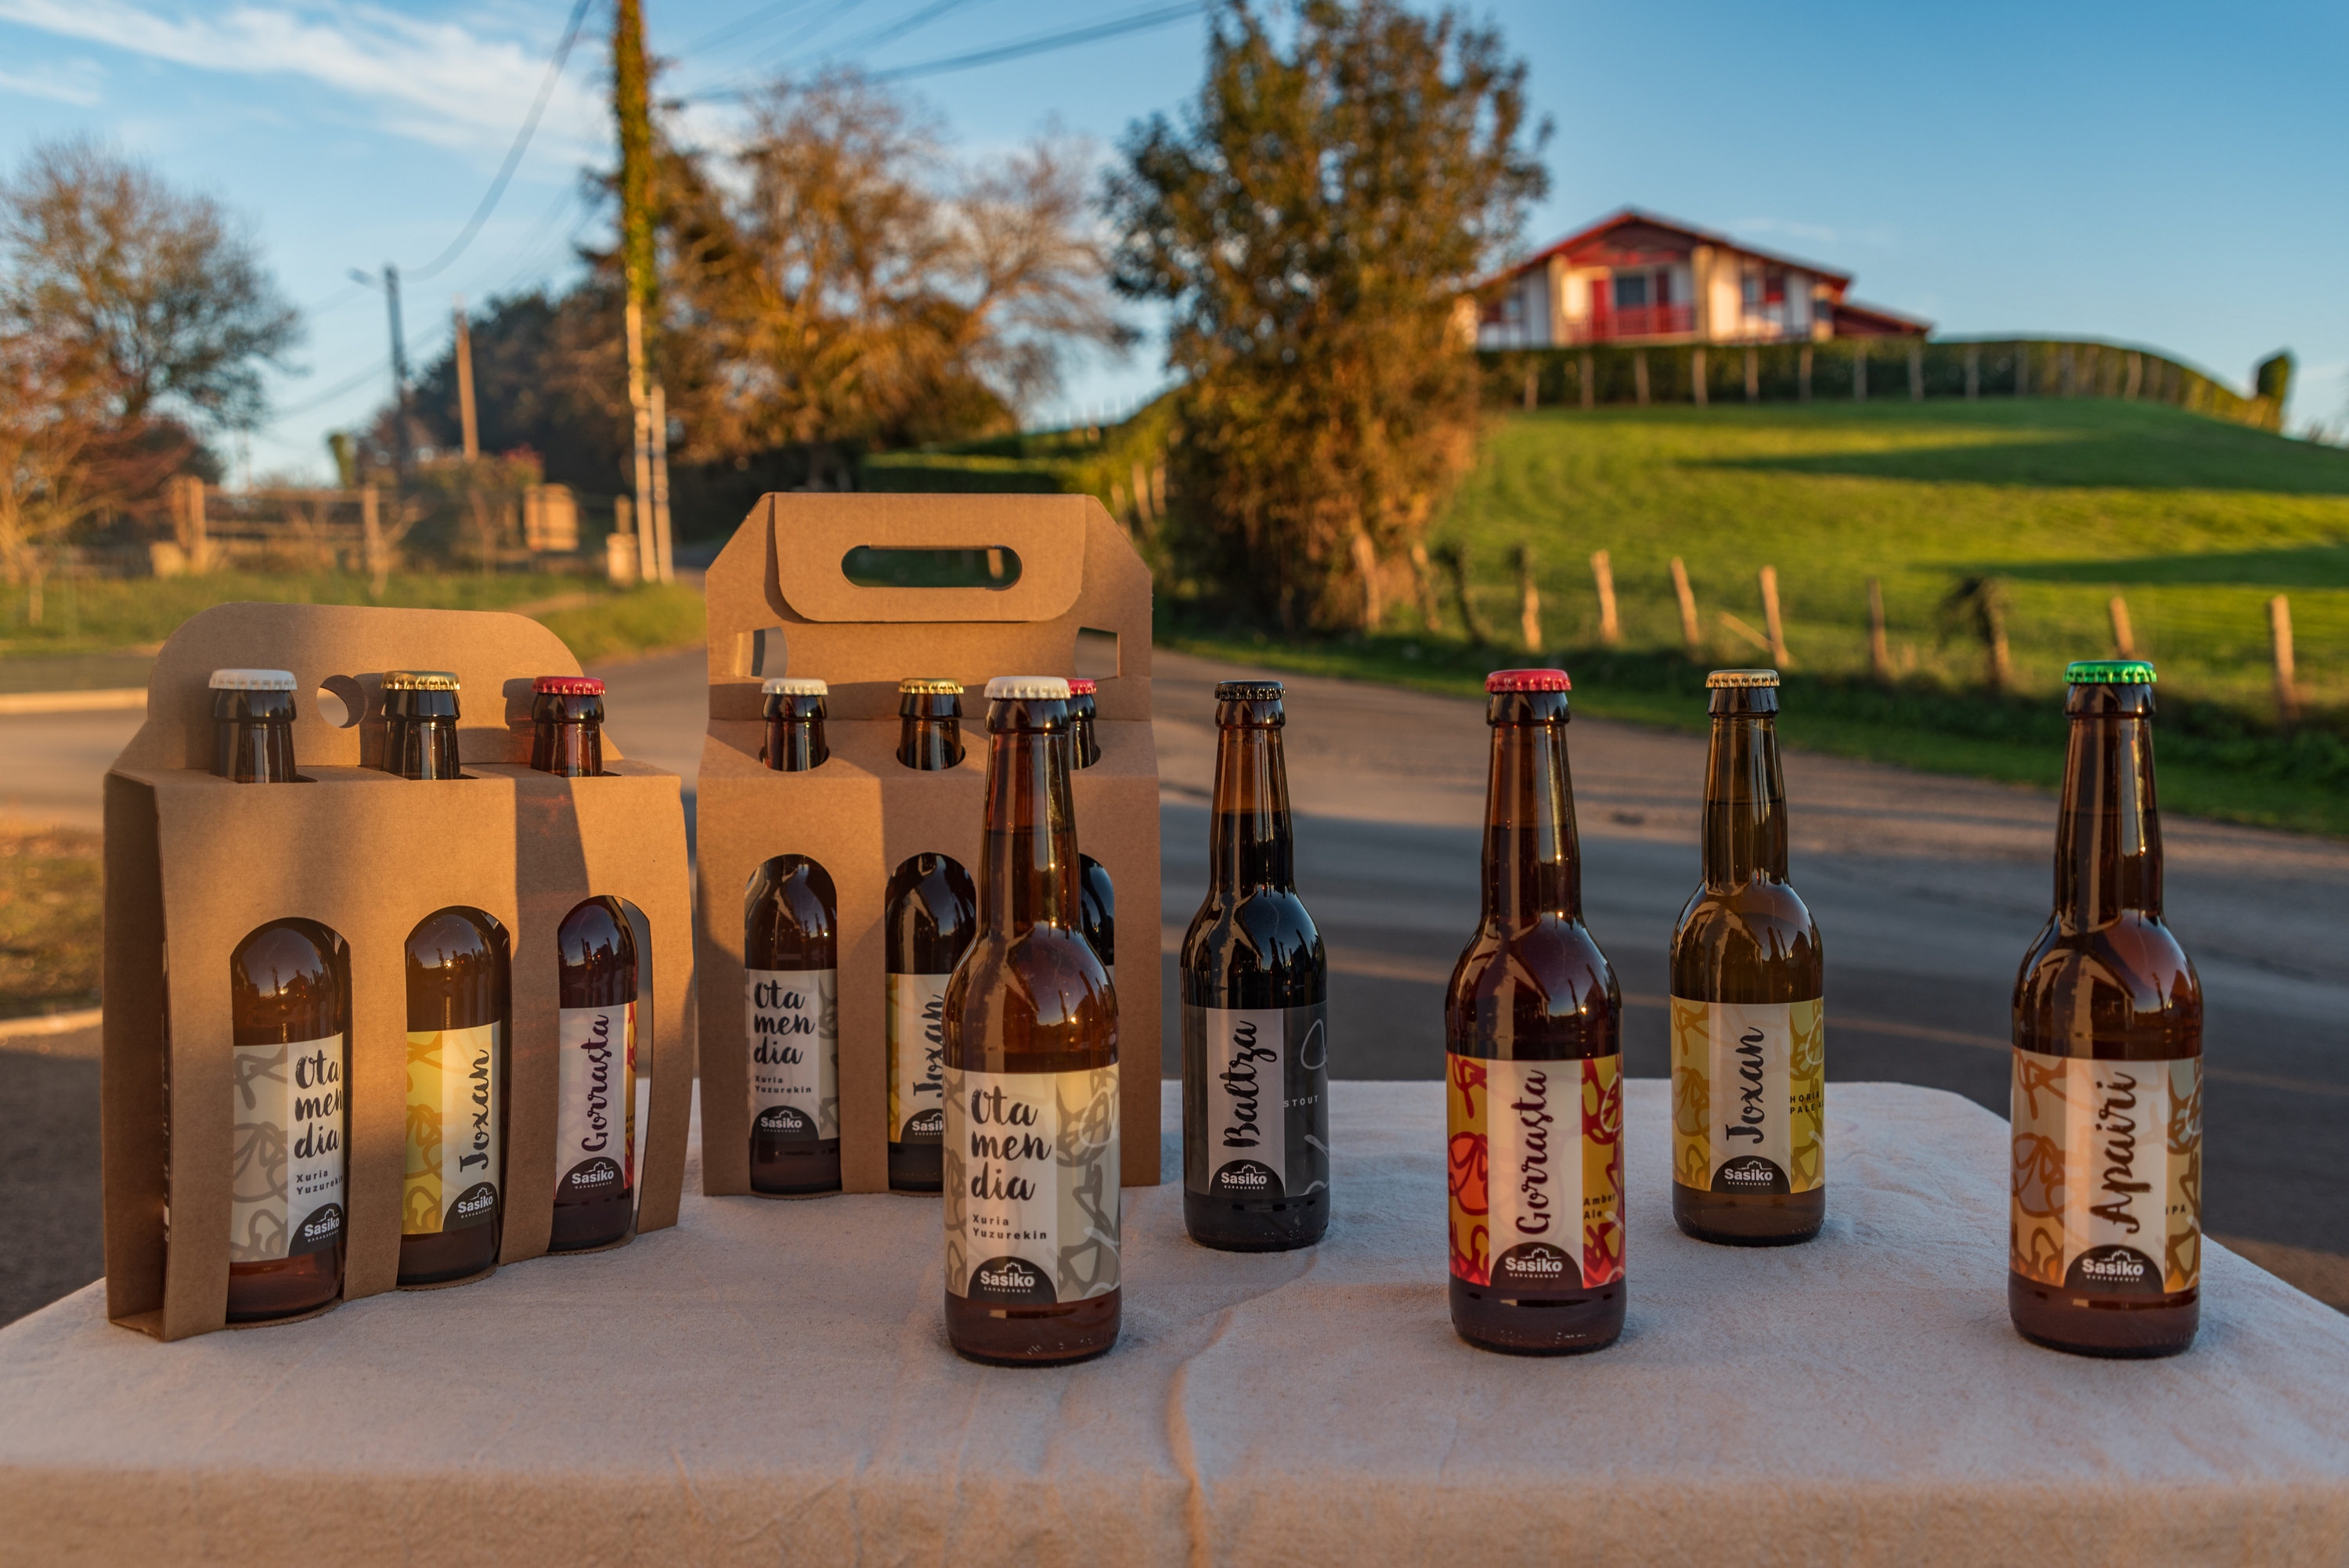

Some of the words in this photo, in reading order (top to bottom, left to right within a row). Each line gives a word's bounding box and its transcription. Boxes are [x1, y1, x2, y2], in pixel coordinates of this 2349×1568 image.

[754, 979, 805, 1009] Ota
[754, 1013, 815, 1035] men
[753, 1036, 803, 1065] dia
[912, 994, 944, 1098] Joxan
[295, 1050, 341, 1089] Ota
[580, 1015, 612, 1152] Gorrasta
[754, 1076, 783, 1084] Xuria
[1219, 1020, 1277, 1148] Baltza
[1725, 1026, 1765, 1144] Joxan
[754, 1085, 811, 1094] Yuzurekin
[1790, 1090, 1819, 1103] HORIA
[295, 1087, 343, 1122] men
[971, 1086, 1038, 1126] Ota
[1283, 1095, 1319, 1108] STOUT
[1790, 1103, 1815, 1114] PALE
[459, 1049, 489, 1173] Joxan
[760, 1117, 803, 1128] Sasiko
[911, 1120, 944, 1131] Sasik
[294, 1122, 341, 1159] dia
[971, 1131, 1052, 1161] men
[1510, 1069, 1553, 1235] Gorrasta
[2089, 1072, 2152, 1234] Apairi
[296, 1170, 328, 1183] Xuria
[572, 1170, 615, 1184] Sasiko
[970, 1161, 1036, 1201] dia
[1221, 1172, 1268, 1184] Sasiko
[1724, 1168, 1773, 1181] Sasiko
[457, 1195, 493, 1213] Sasiko
[1583, 1193, 1616, 1206] Amber
[1583, 1210, 1602, 1220] Ale
[2166, 1204, 2185, 1216] IPA
[304, 1217, 340, 1237] Sasiko
[972, 1214, 1009, 1227] Xuria
[972, 1227, 1047, 1240] Yuzurekin
[1505, 1257, 1563, 1272] Sasiko
[2082, 1259, 2145, 1276] Sasiko
[980, 1271, 1035, 1288] Sasiko
